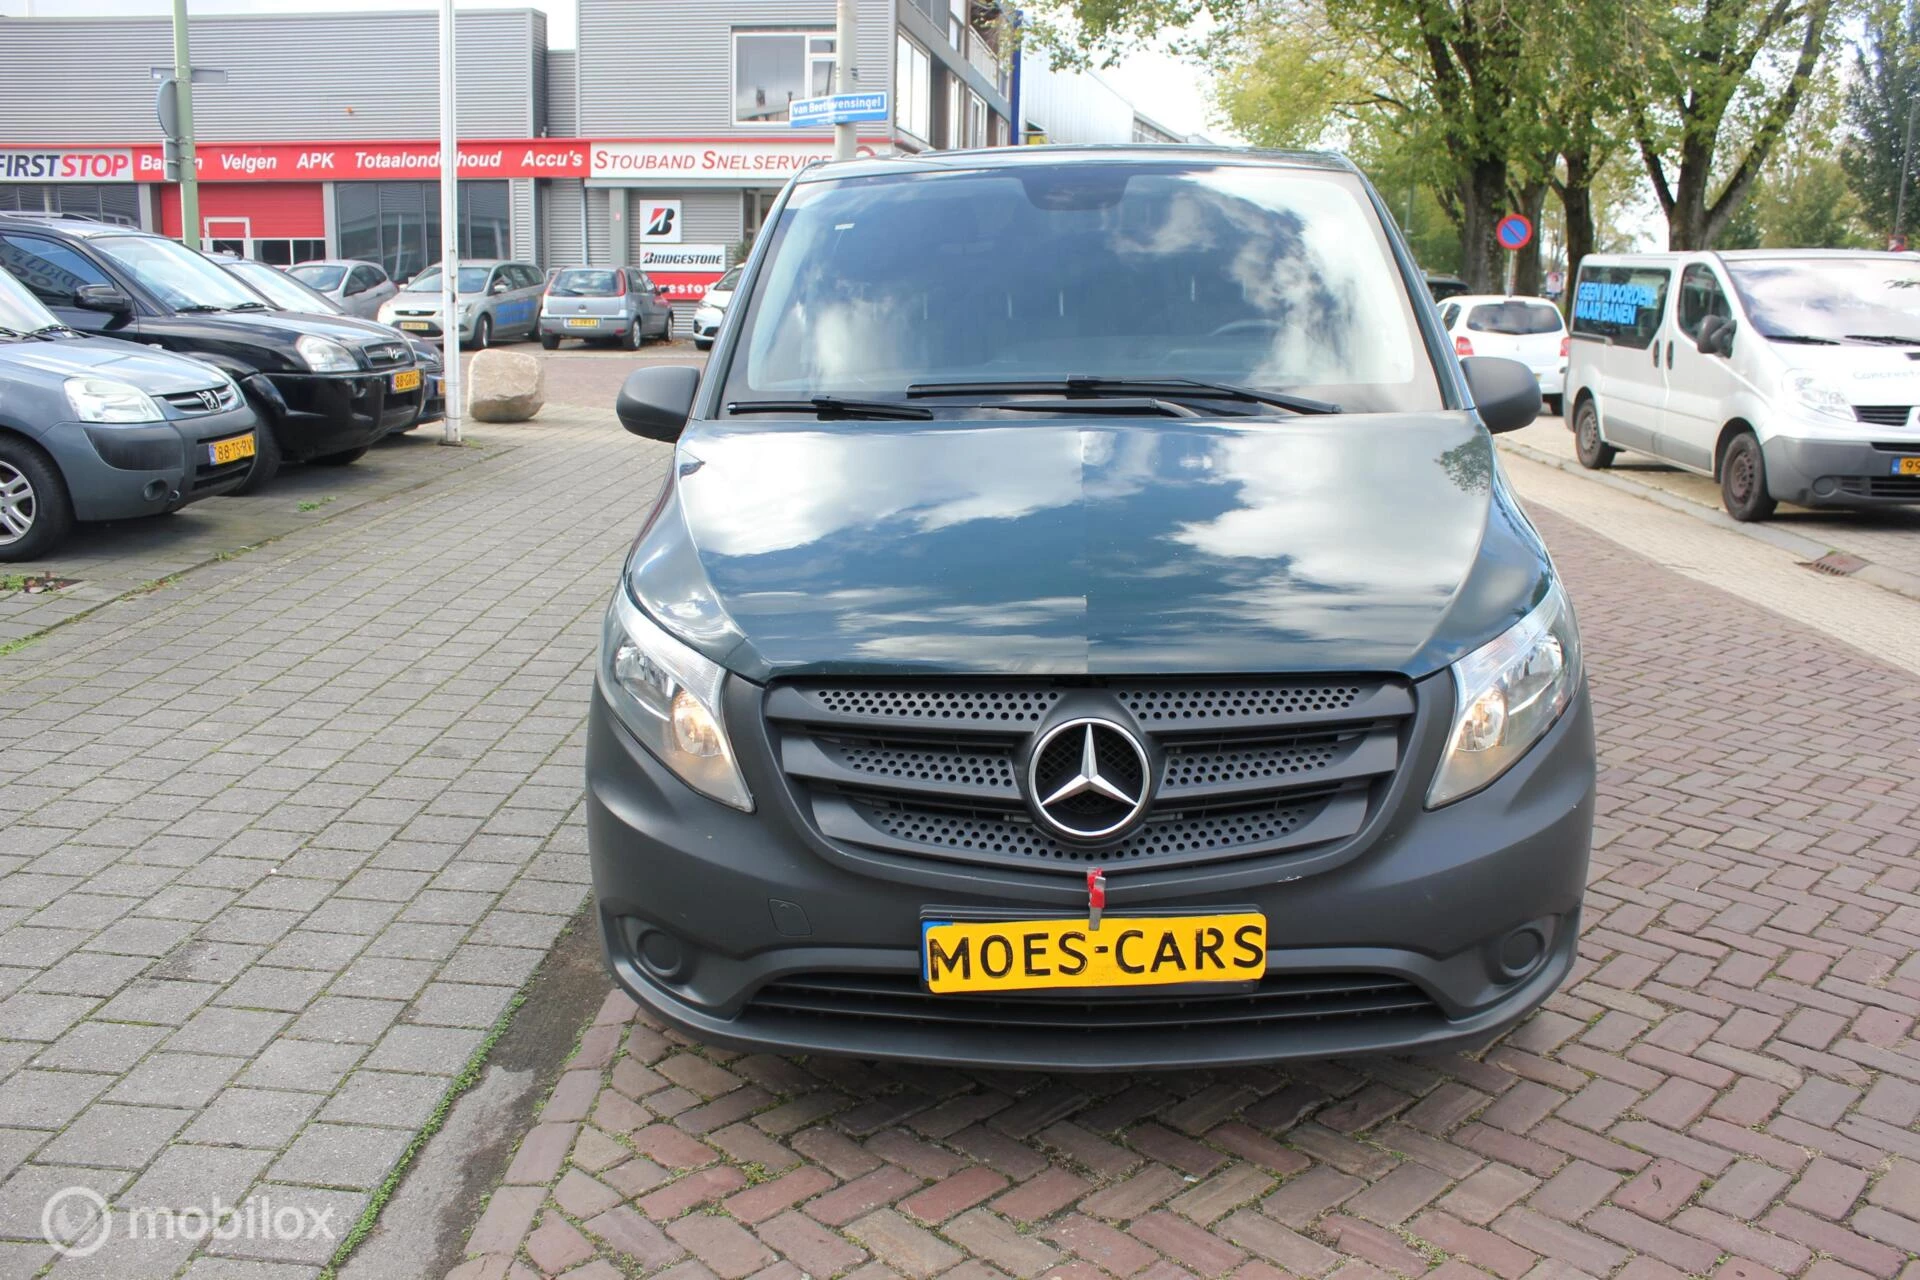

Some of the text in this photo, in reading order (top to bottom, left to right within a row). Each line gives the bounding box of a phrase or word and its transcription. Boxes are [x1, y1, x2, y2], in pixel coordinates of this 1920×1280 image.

[793, 104, 808, 115] van
[140, 150, 584, 171] Ban Velgen APK Totaalondhoud Accu's
[594, 150, 696, 170] STOUBAND
[643, 252, 723, 265] BRIDGESTONE
[928, 924, 1264, 982] MOES-CARS
